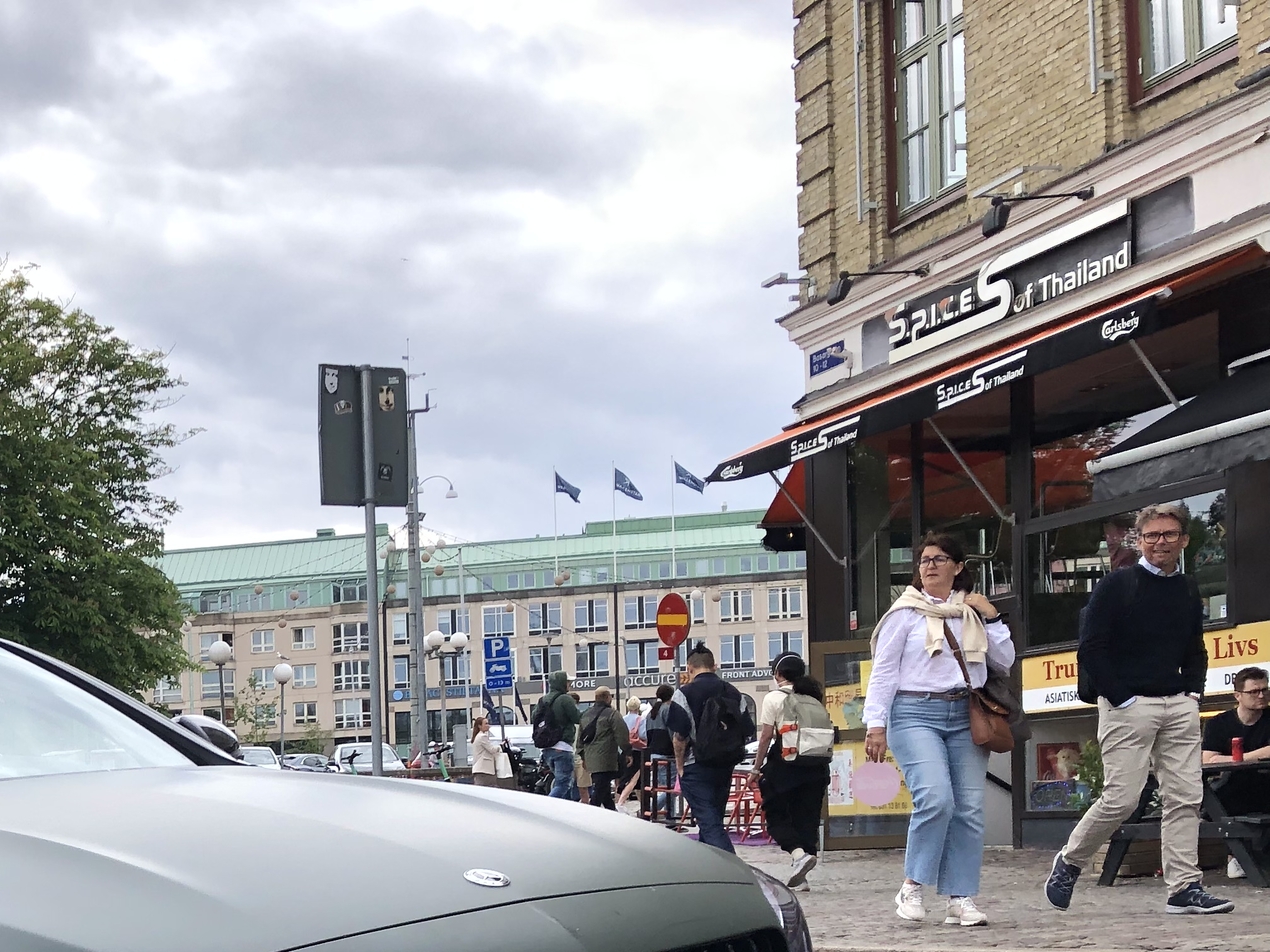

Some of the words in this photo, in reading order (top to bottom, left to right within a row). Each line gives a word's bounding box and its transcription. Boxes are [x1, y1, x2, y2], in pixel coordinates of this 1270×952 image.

[1013, 287, 1034, 314] of
[1040, 240, 1132, 302] Thailand
[1101, 311, 1140, 340] Carlsberg
[985, 378, 993, 391] of
[994, 365, 1025, 387] Thailand
[491, 639, 504, 657] P
[663, 649, 668, 658] 4
[1042, 659, 1080, 681] Tru
[1213, 634, 1259, 660] Livs
[721, 670, 750, 679] FRONT
